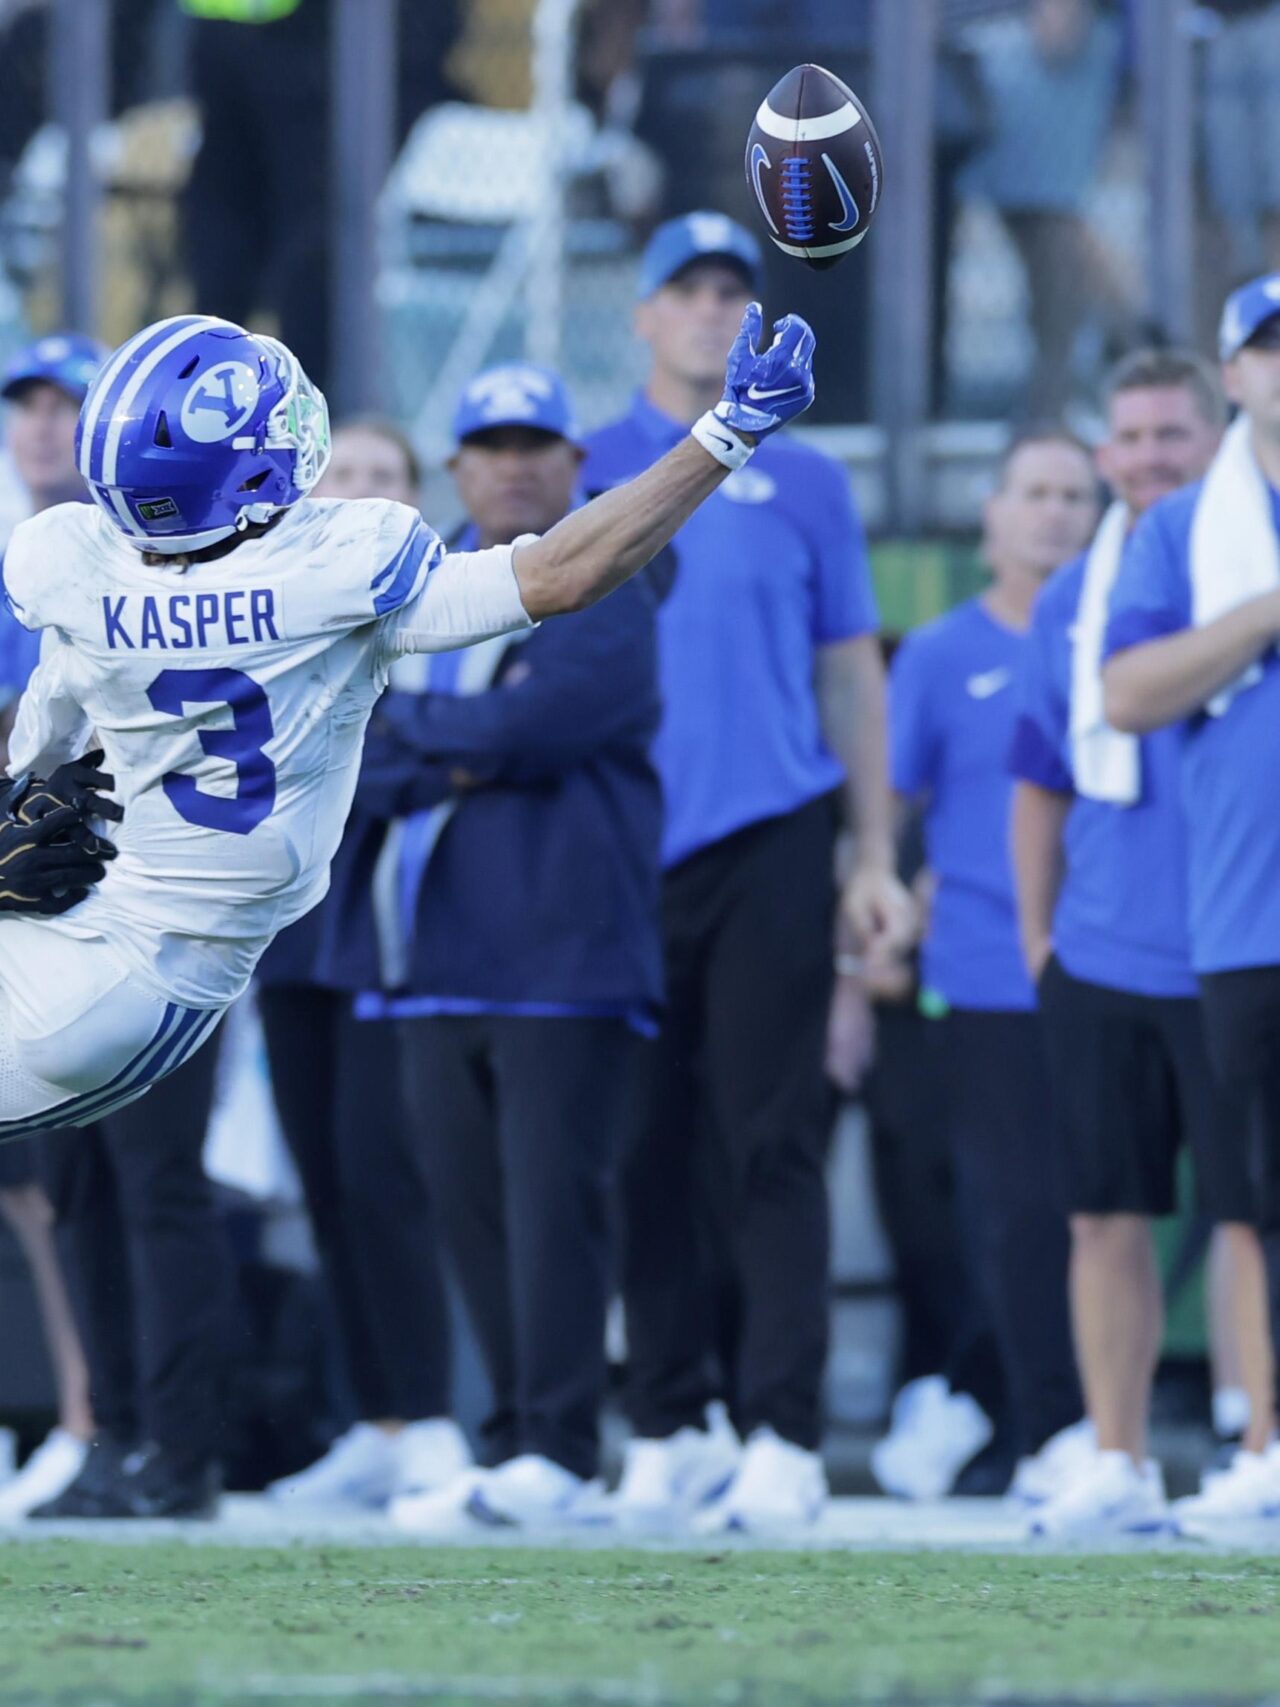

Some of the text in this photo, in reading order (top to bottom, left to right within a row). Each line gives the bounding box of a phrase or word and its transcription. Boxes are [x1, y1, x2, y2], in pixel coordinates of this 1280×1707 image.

[188, 368, 247, 429] Y
[102, 588, 280, 649] KASPER
[146, 667, 276, 835] 3
